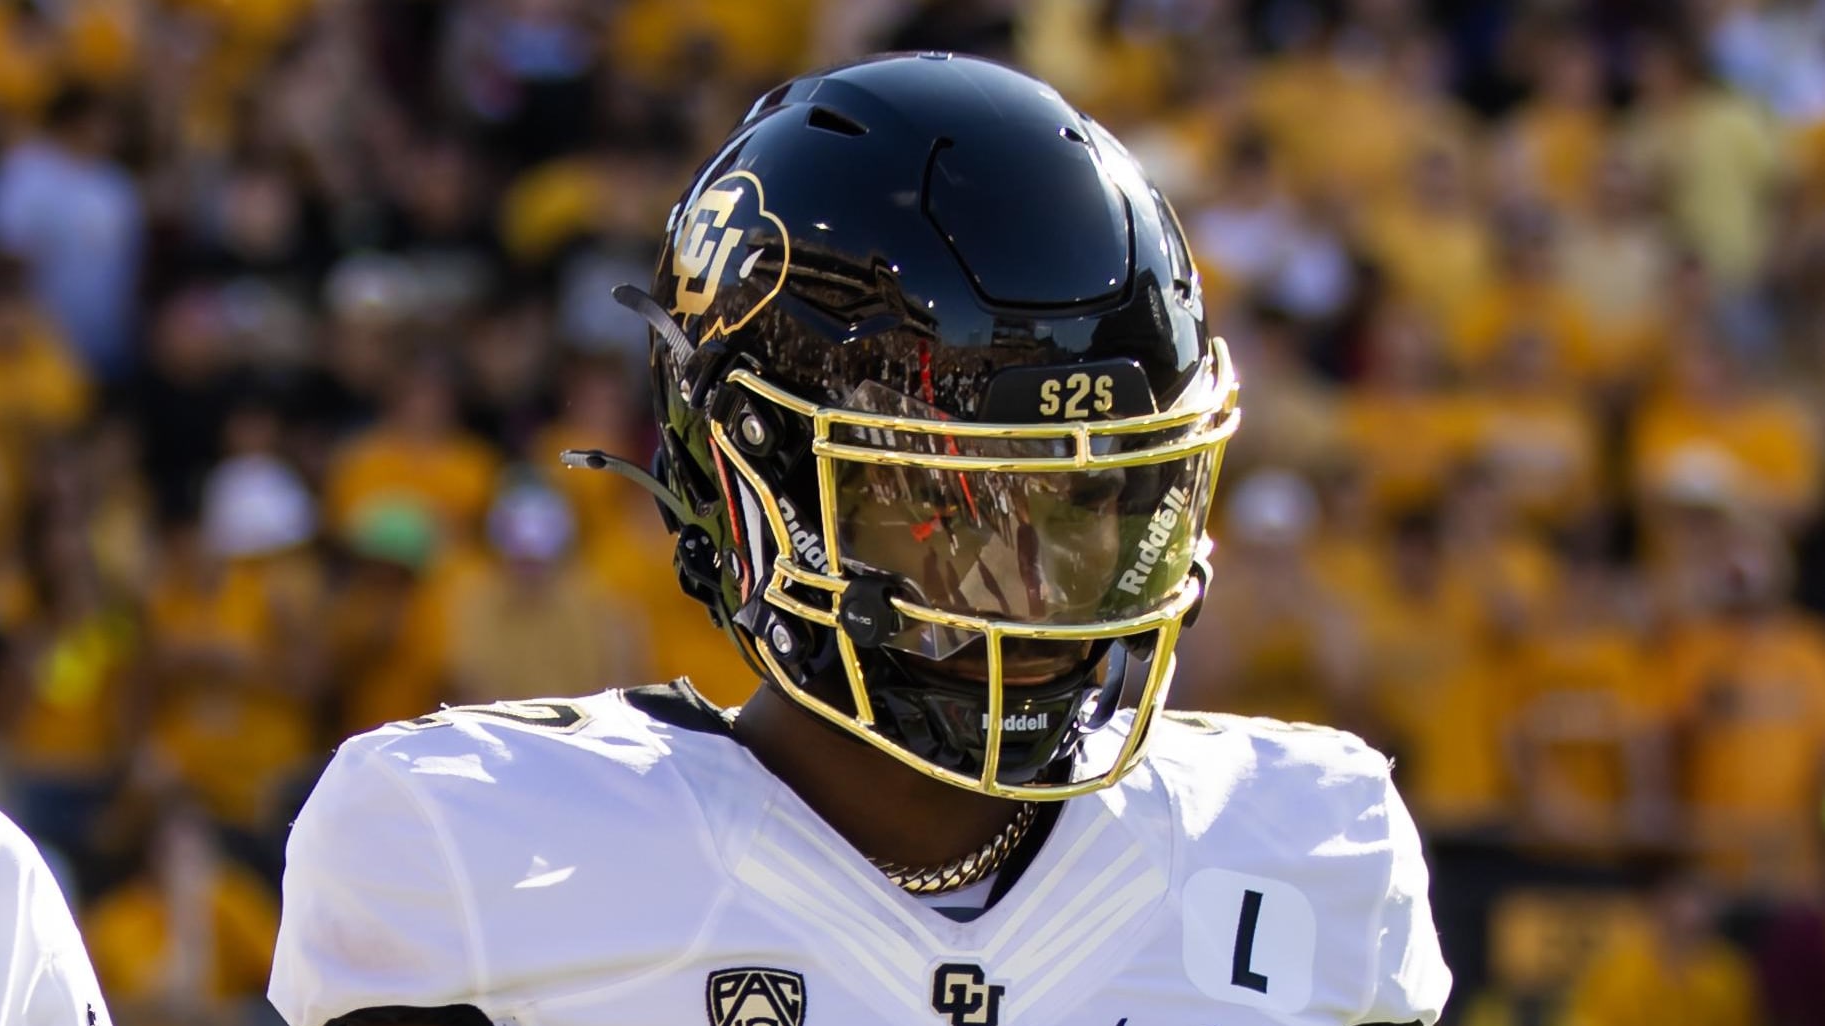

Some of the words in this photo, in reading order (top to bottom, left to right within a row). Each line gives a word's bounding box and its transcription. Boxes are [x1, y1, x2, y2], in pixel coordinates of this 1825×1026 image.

[1039, 372, 1114, 419] S2S
[1117, 485, 1186, 595] Riddell
[1231, 888, 1269, 994] L
